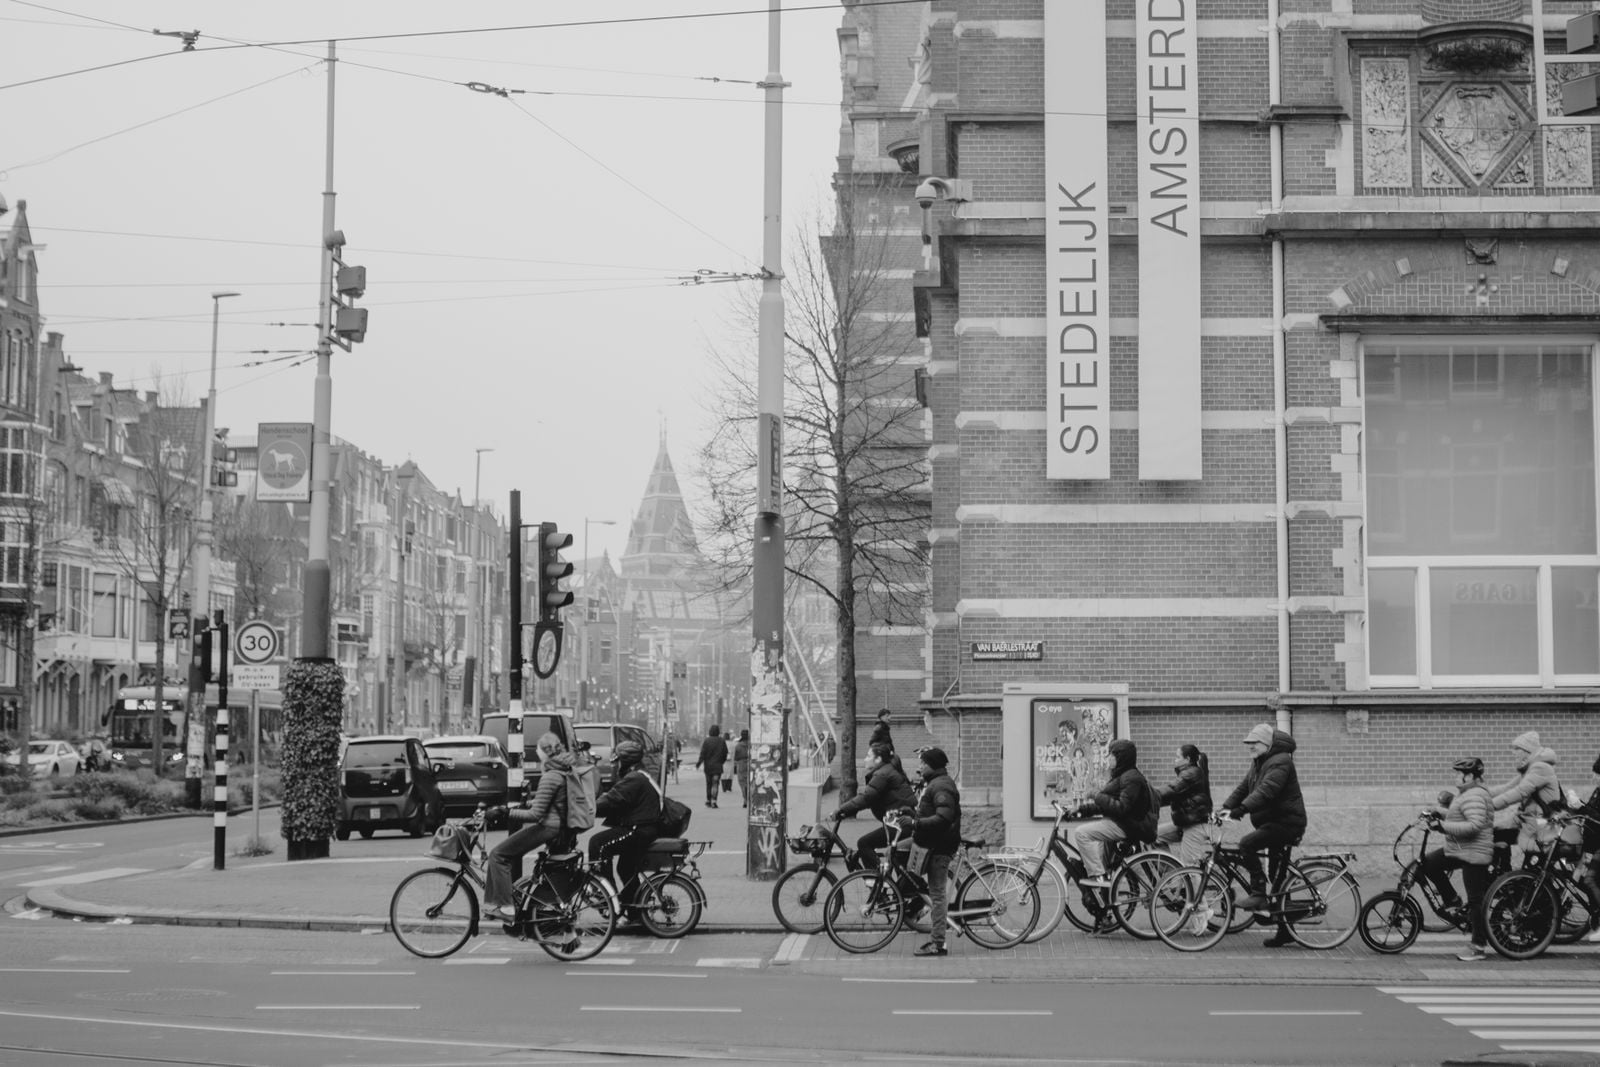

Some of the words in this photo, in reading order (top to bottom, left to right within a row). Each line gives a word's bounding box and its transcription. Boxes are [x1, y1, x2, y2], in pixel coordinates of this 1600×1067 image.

[1058, 182, 1099, 455] STEDELIJK
[244, 635, 270, 650] 30
[976, 643, 991, 652] VAN
[1048, 705, 1062, 714] eye
[1036, 745, 1064, 757] DICK
[1036, 756, 1070, 767] MAAS
